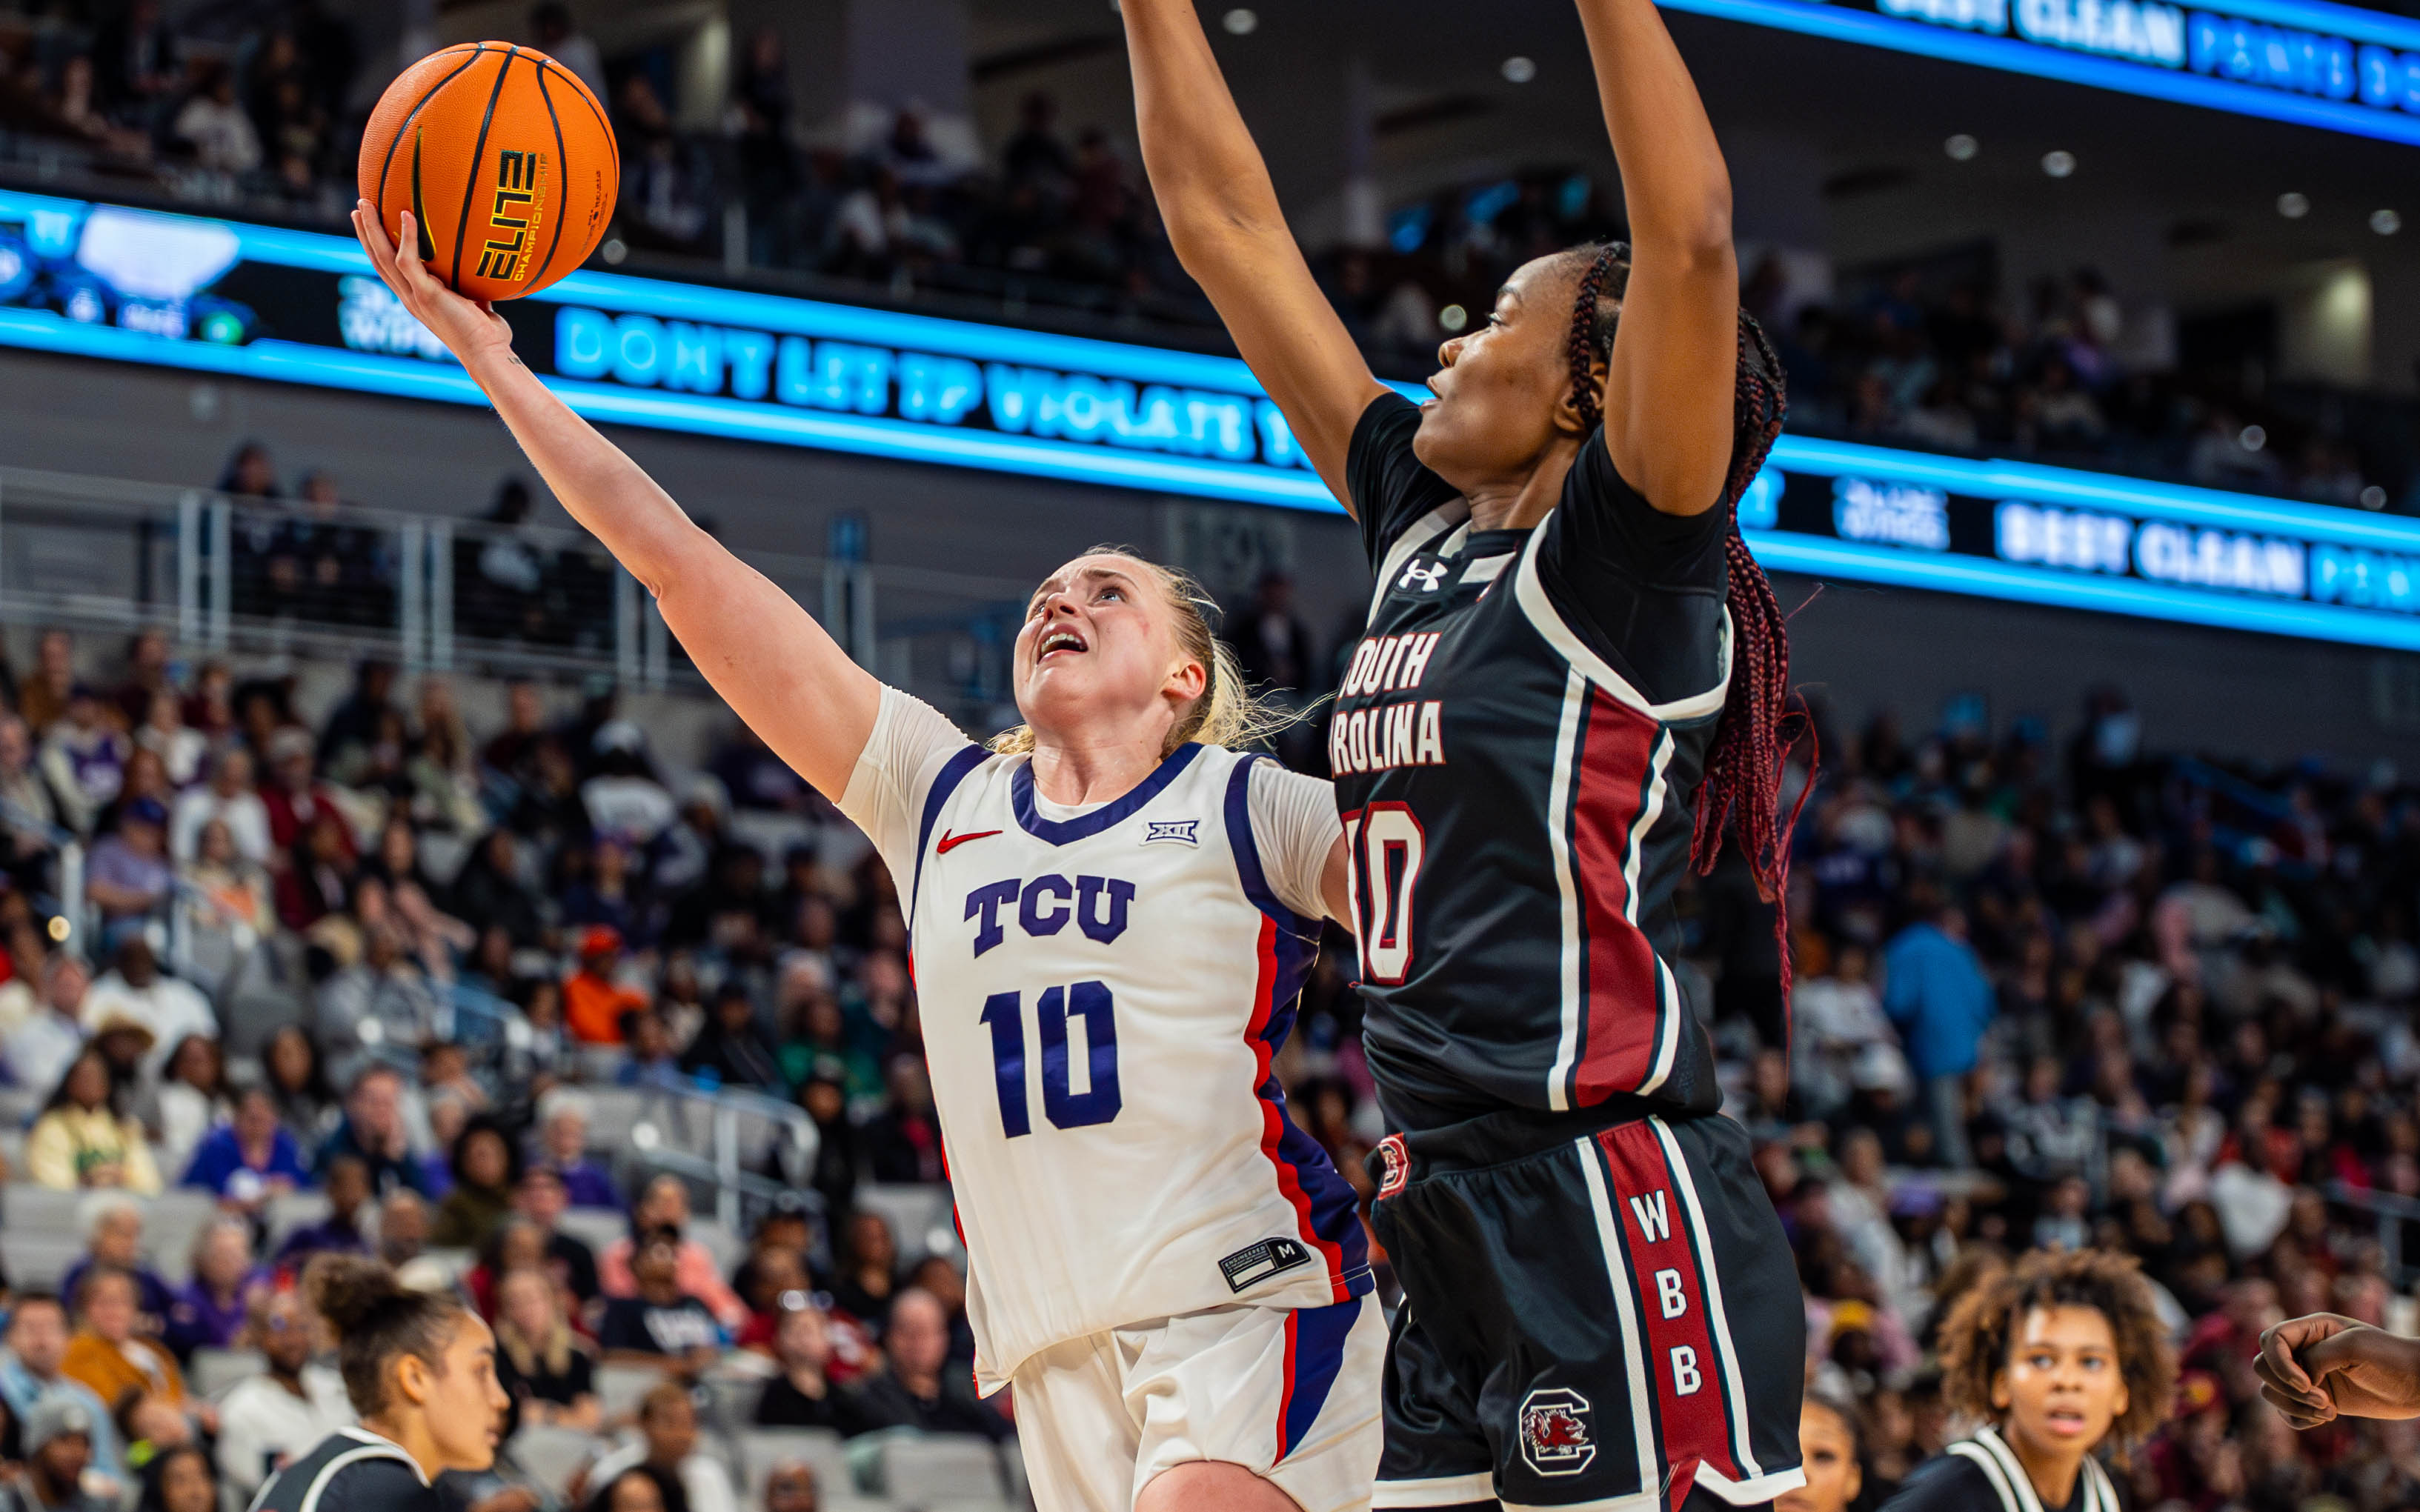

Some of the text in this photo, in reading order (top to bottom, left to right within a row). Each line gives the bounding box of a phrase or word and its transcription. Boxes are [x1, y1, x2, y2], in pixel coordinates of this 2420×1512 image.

[475, 150, 536, 280] ELITE
[513, 153, 548, 282] CHAMPIONSHIP
[985, 363, 1256, 464] VIOLATE
[1994, 499, 2135, 578] BEST
[2133, 517, 2307, 602] CLEAN
[1337, 631, 1443, 699] OUTH
[1329, 699, 1446, 778] ROLINA
[964, 873, 1136, 959] TCU
[980, 980, 1123, 1139] 10
[1277, 1243, 1296, 1259] M
